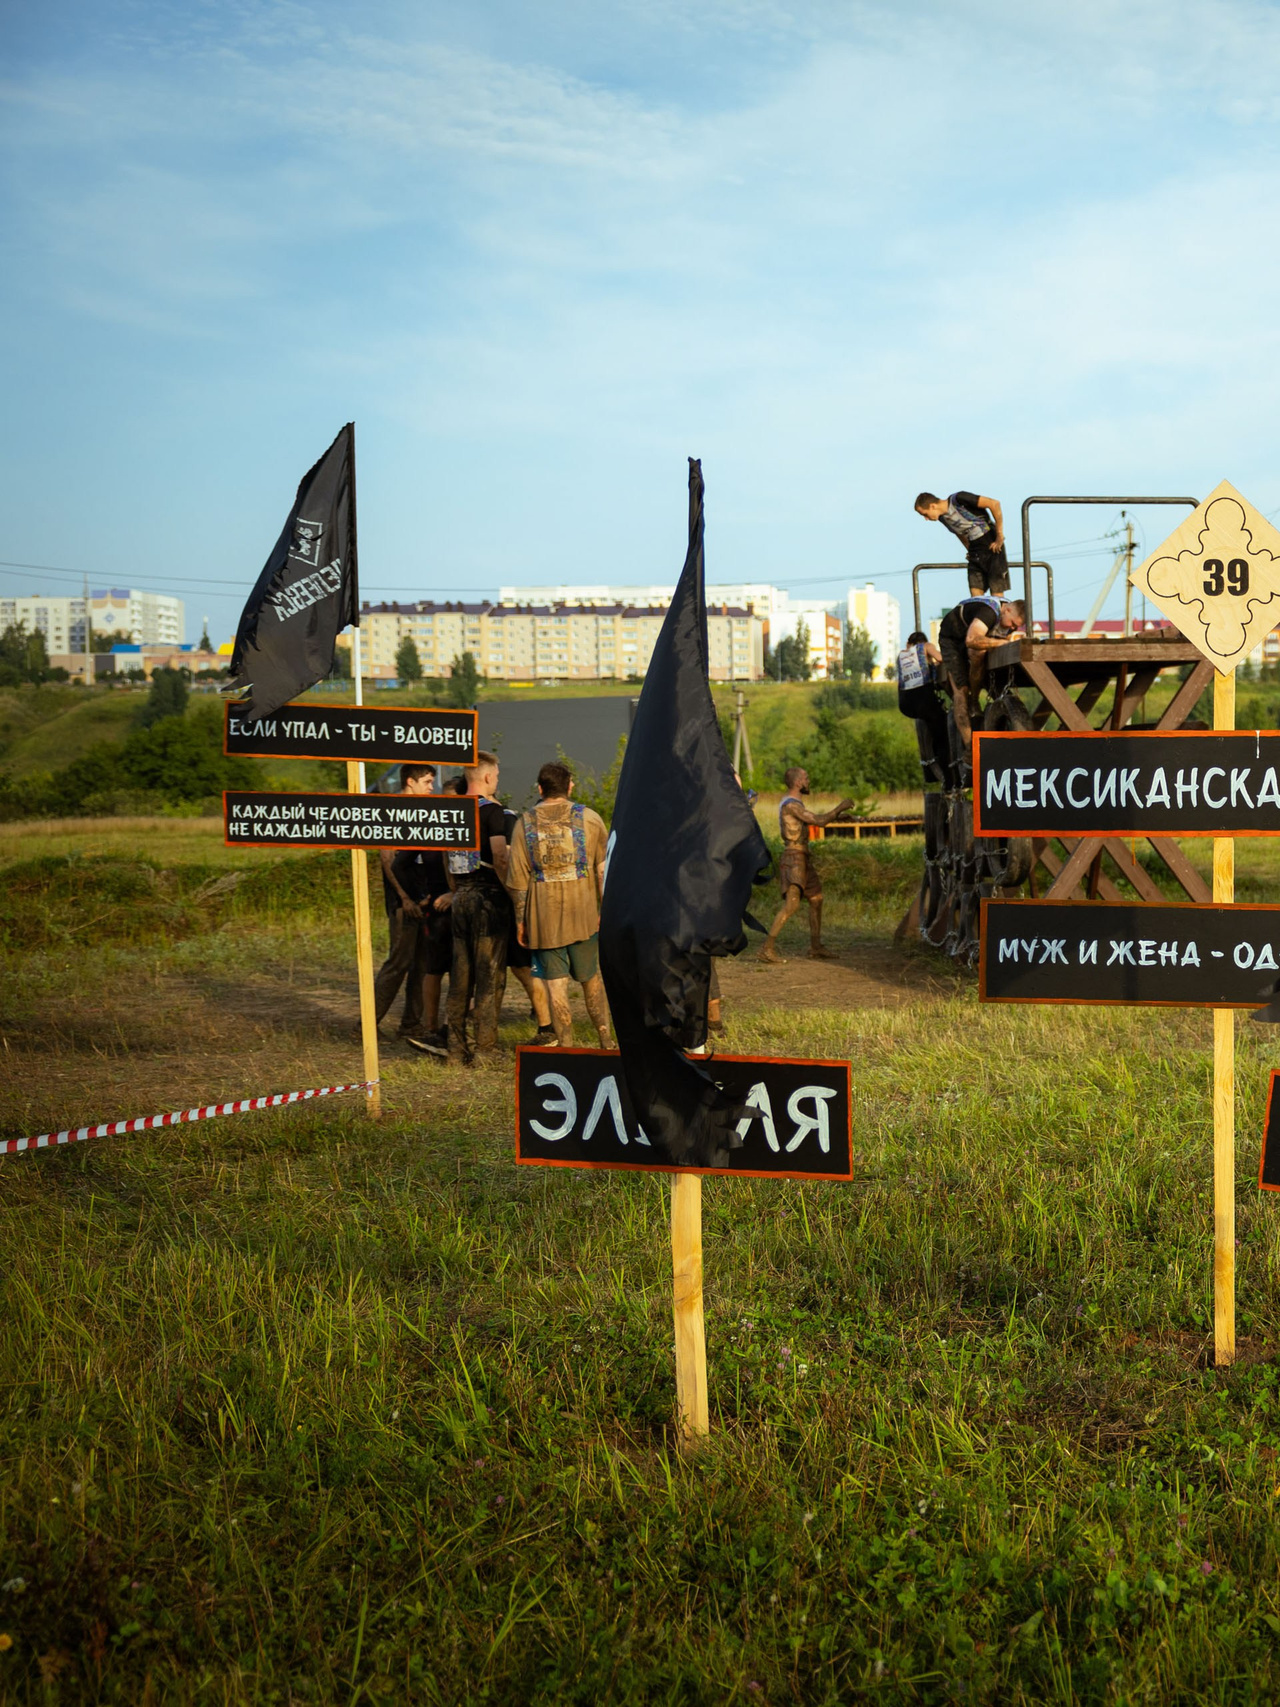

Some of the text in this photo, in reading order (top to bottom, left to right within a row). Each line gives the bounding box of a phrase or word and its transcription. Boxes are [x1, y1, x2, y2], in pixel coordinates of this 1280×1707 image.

[1202, 558, 1250, 598] 39
[229, 718, 277, 738] ЕСЛИ
[282, 720, 330, 740] УПАЛ
[347, 723, 376, 742] ТЫ
[394, 725, 473, 751] ВДОВЕЦ!
[232, 802, 466, 825] КАЖДЫЙ ЧЕЛОВЕК УМИРАЕТ!
[229, 821, 470, 842] НЕ КАЖДЫЙ ЧЕЛОВЕК ЖИВЕТ!
[998, 938, 1069, 965] МУЖ
[1079, 939, 1098, 965] И
[1106, 939, 1202, 968] ЖЕНА
